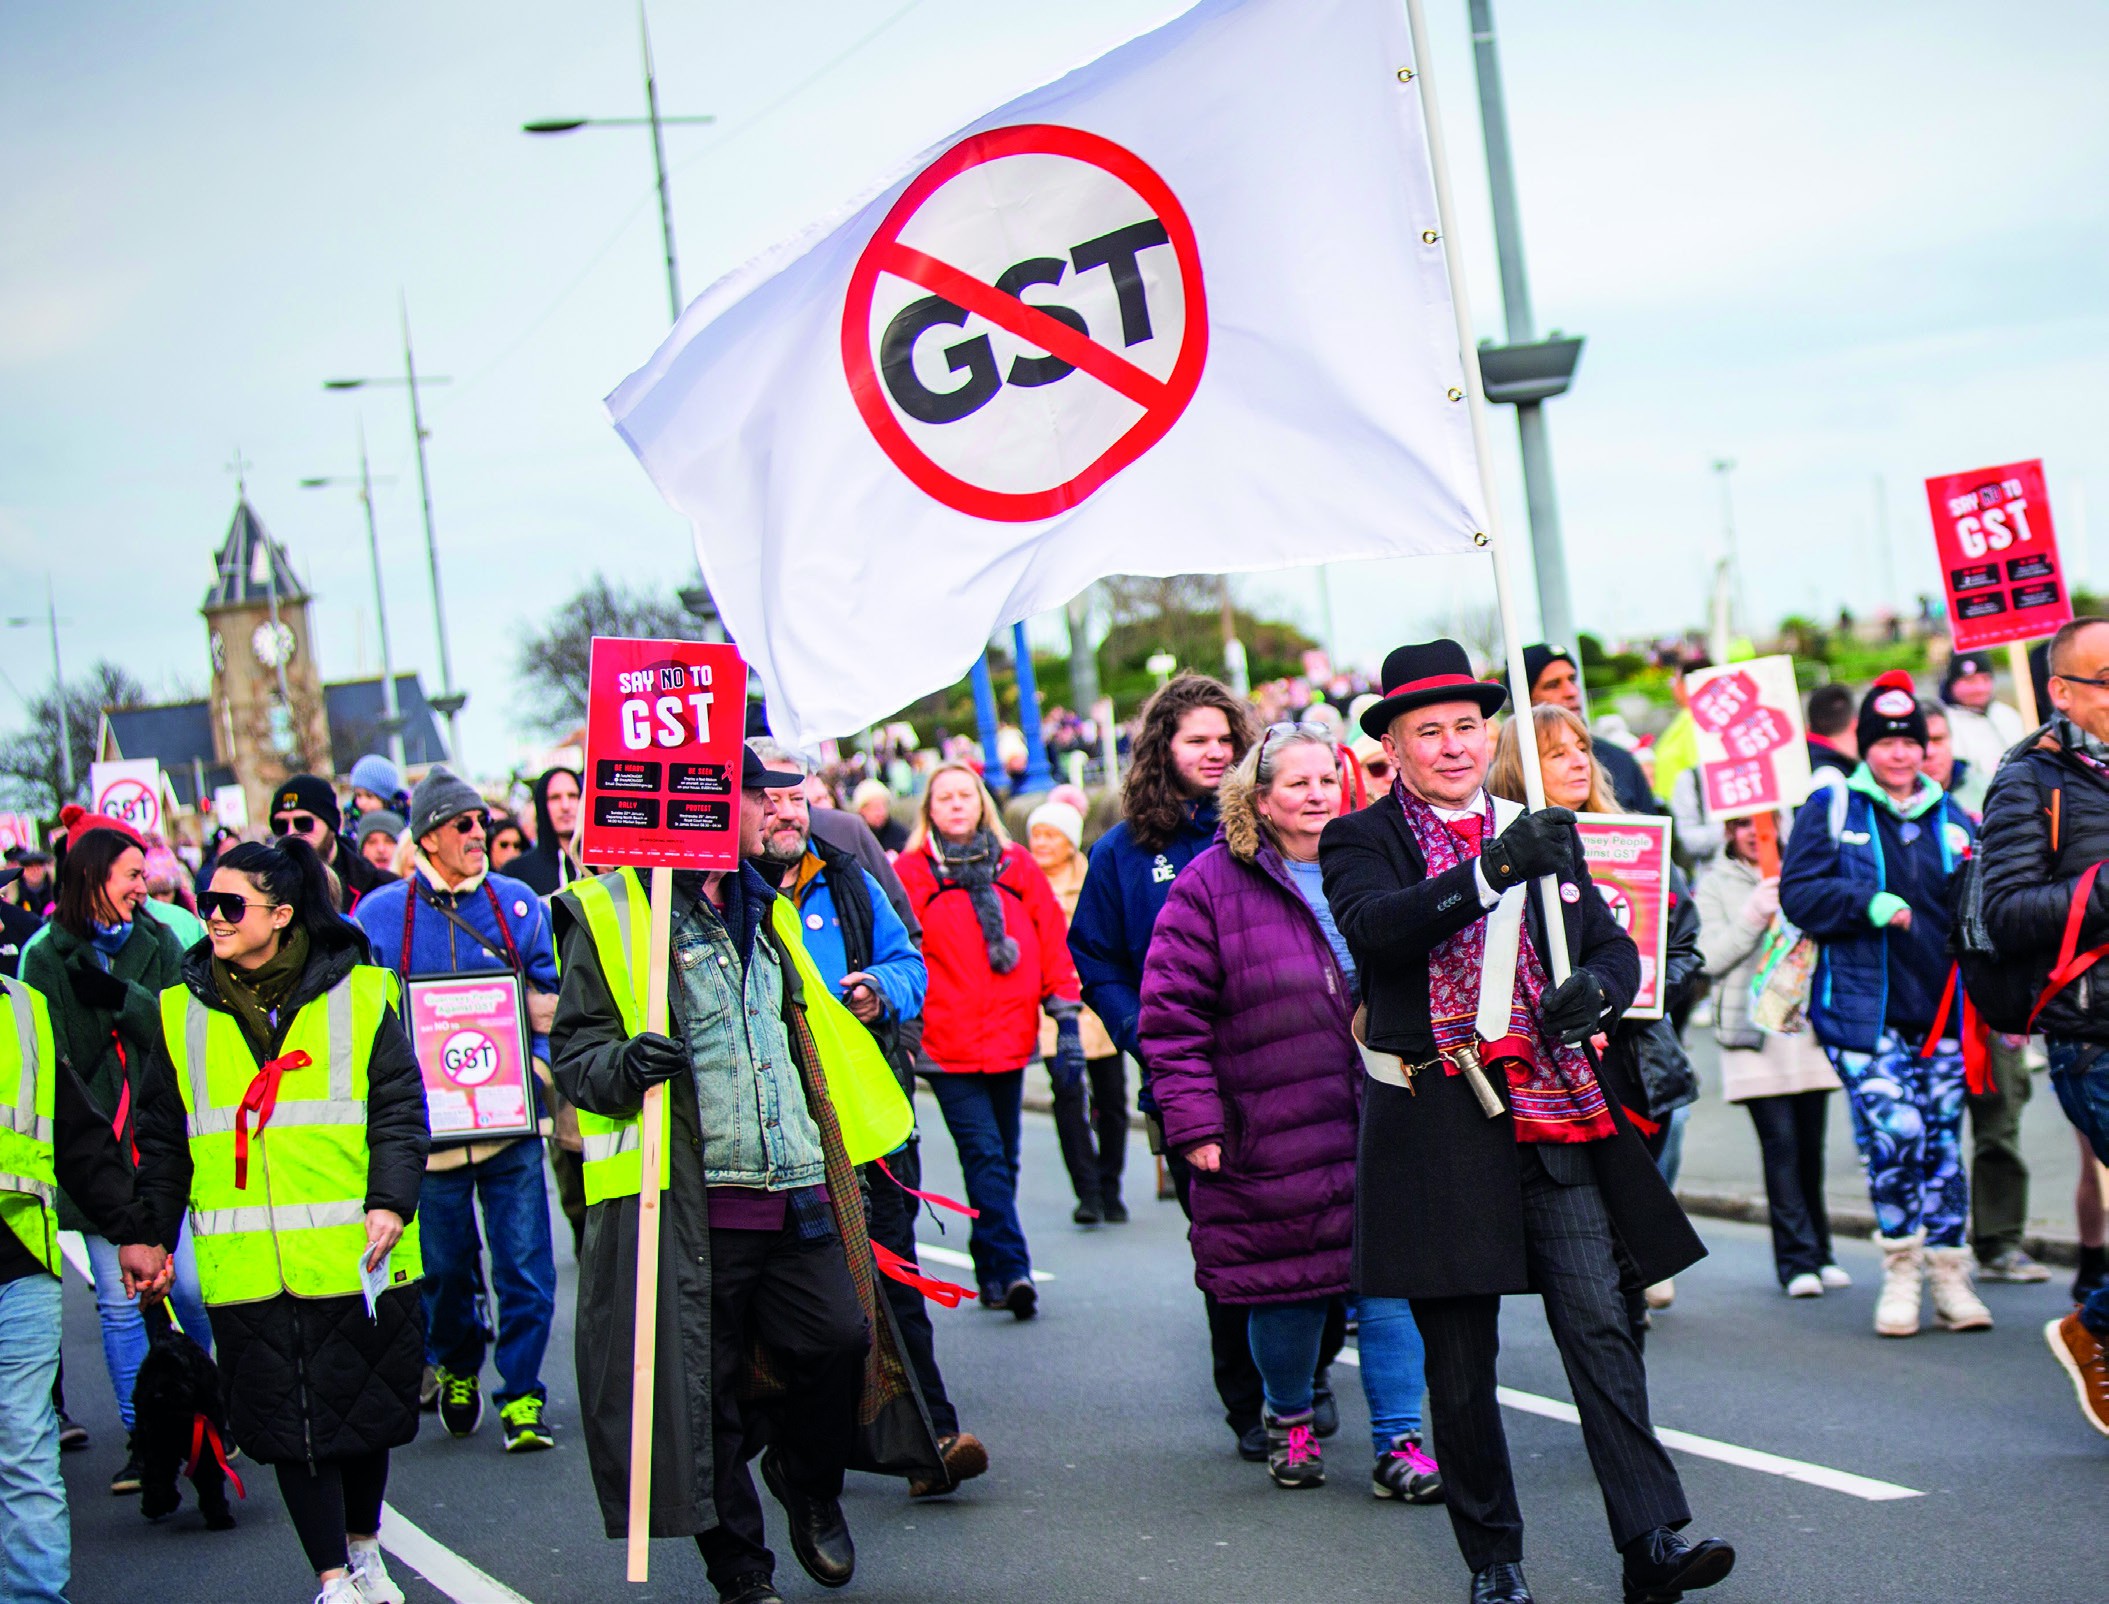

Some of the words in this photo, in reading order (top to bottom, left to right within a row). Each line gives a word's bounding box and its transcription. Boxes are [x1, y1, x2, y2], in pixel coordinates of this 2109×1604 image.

[880, 217, 1170, 424] GST
[1948, 491, 1979, 517] SAY
[1956, 498, 2033, 558] GST
[619, 669, 654, 694] SAY
[660, 667, 684, 691] NO
[689, 665, 713, 687] TO
[621, 692, 715, 750] GST
[1736, 719, 1780, 757] GST
[1719, 772, 1764, 805] GST
[618, 801, 638, 809] RALLY
[685, 804, 712, 812] PROTEST
[1612, 836, 1650, 847] People
[1613, 848, 1637, 859] GST
[434, 1020, 450, 1032] NO
[445, 1046, 492, 1070] GST
